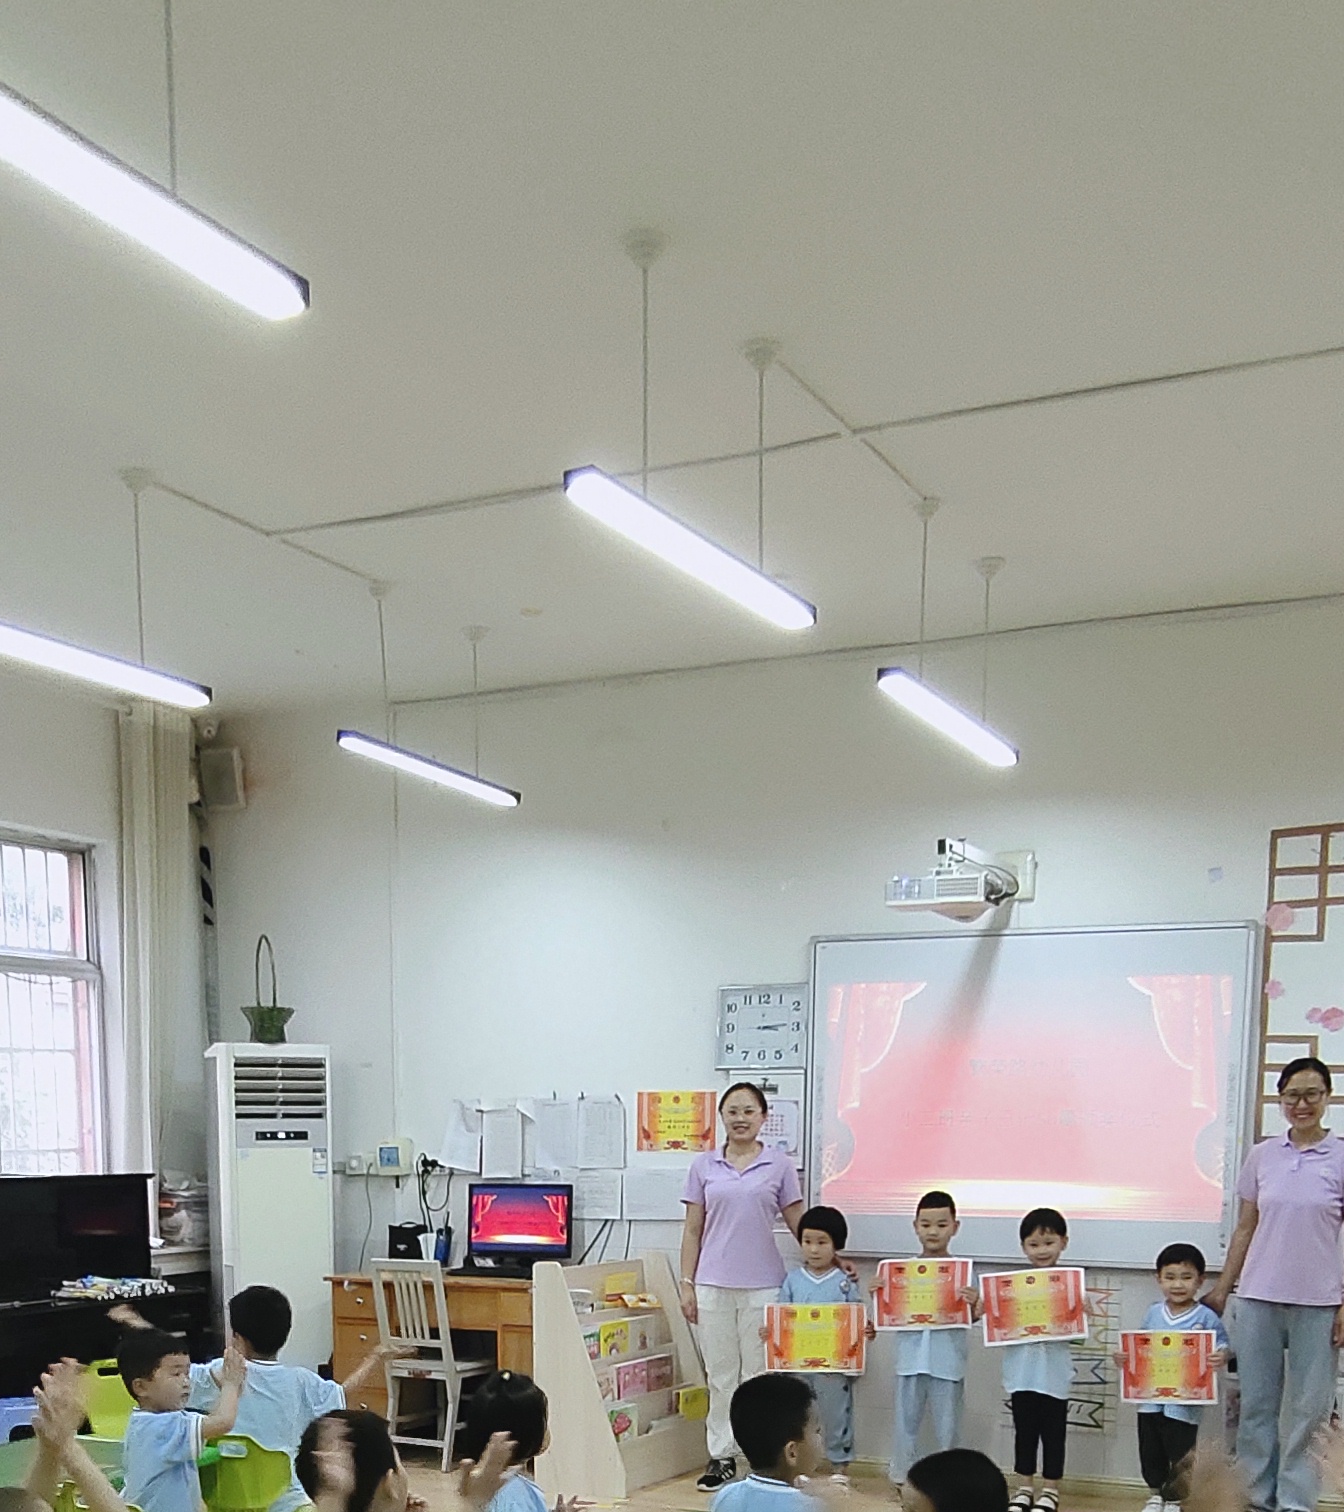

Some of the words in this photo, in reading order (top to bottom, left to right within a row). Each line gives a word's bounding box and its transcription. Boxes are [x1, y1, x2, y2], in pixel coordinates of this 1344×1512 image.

[743, 994, 752, 1005] 11
[758, 993, 771, 1004] 12
[778, 994, 783, 1005] 1
[726, 1002, 737, 1013] 10
[792, 1001, 801, 1011] 2
[726, 1023, 735, 1033] 9
[791, 1021, 800, 1031] 3
[725, 1043, 734, 1054] 8
[790, 1043, 799, 1053] 4
[741, 1050, 750, 1061] 7
[757, 1050, 766, 1060] 6
[774, 1050, 783, 1060] 5
